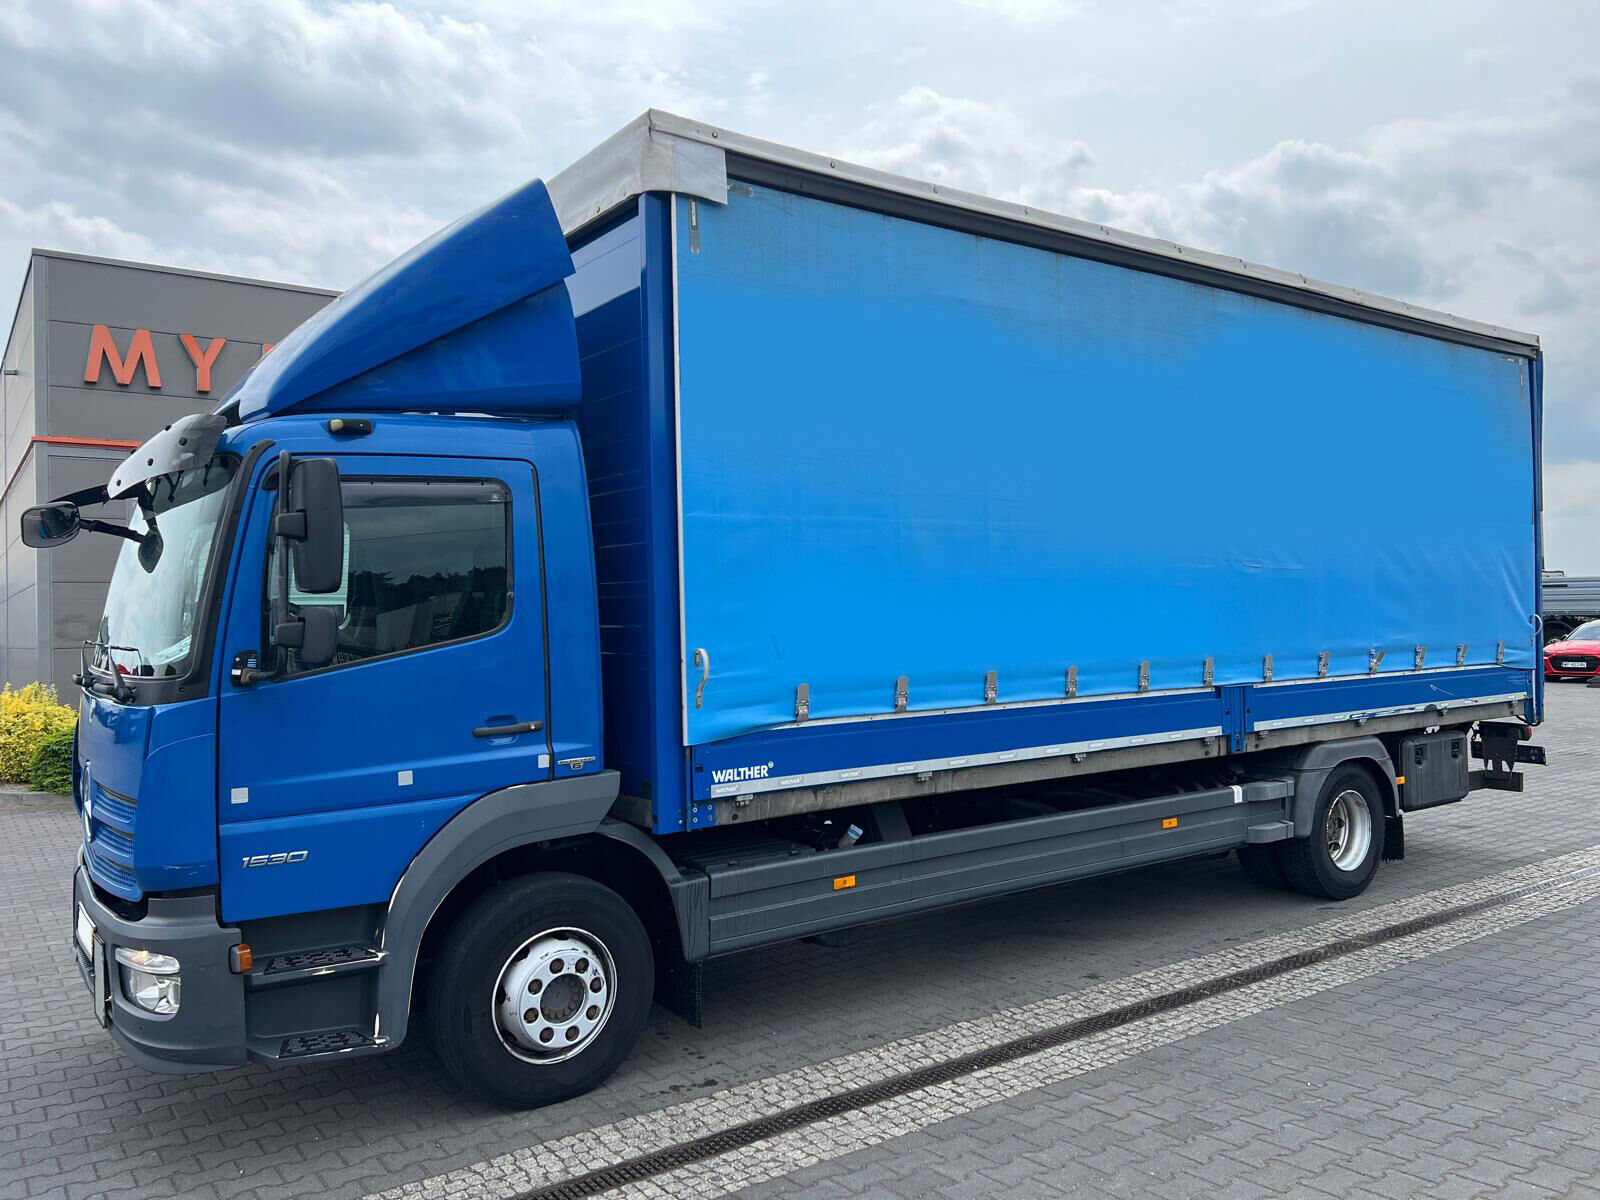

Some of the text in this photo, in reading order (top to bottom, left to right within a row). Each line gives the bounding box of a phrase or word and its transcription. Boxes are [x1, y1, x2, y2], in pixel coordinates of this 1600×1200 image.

[84, 323, 274, 393] MY
[712, 764, 770, 783] WALTHER
[242, 850, 308, 868] 1530
